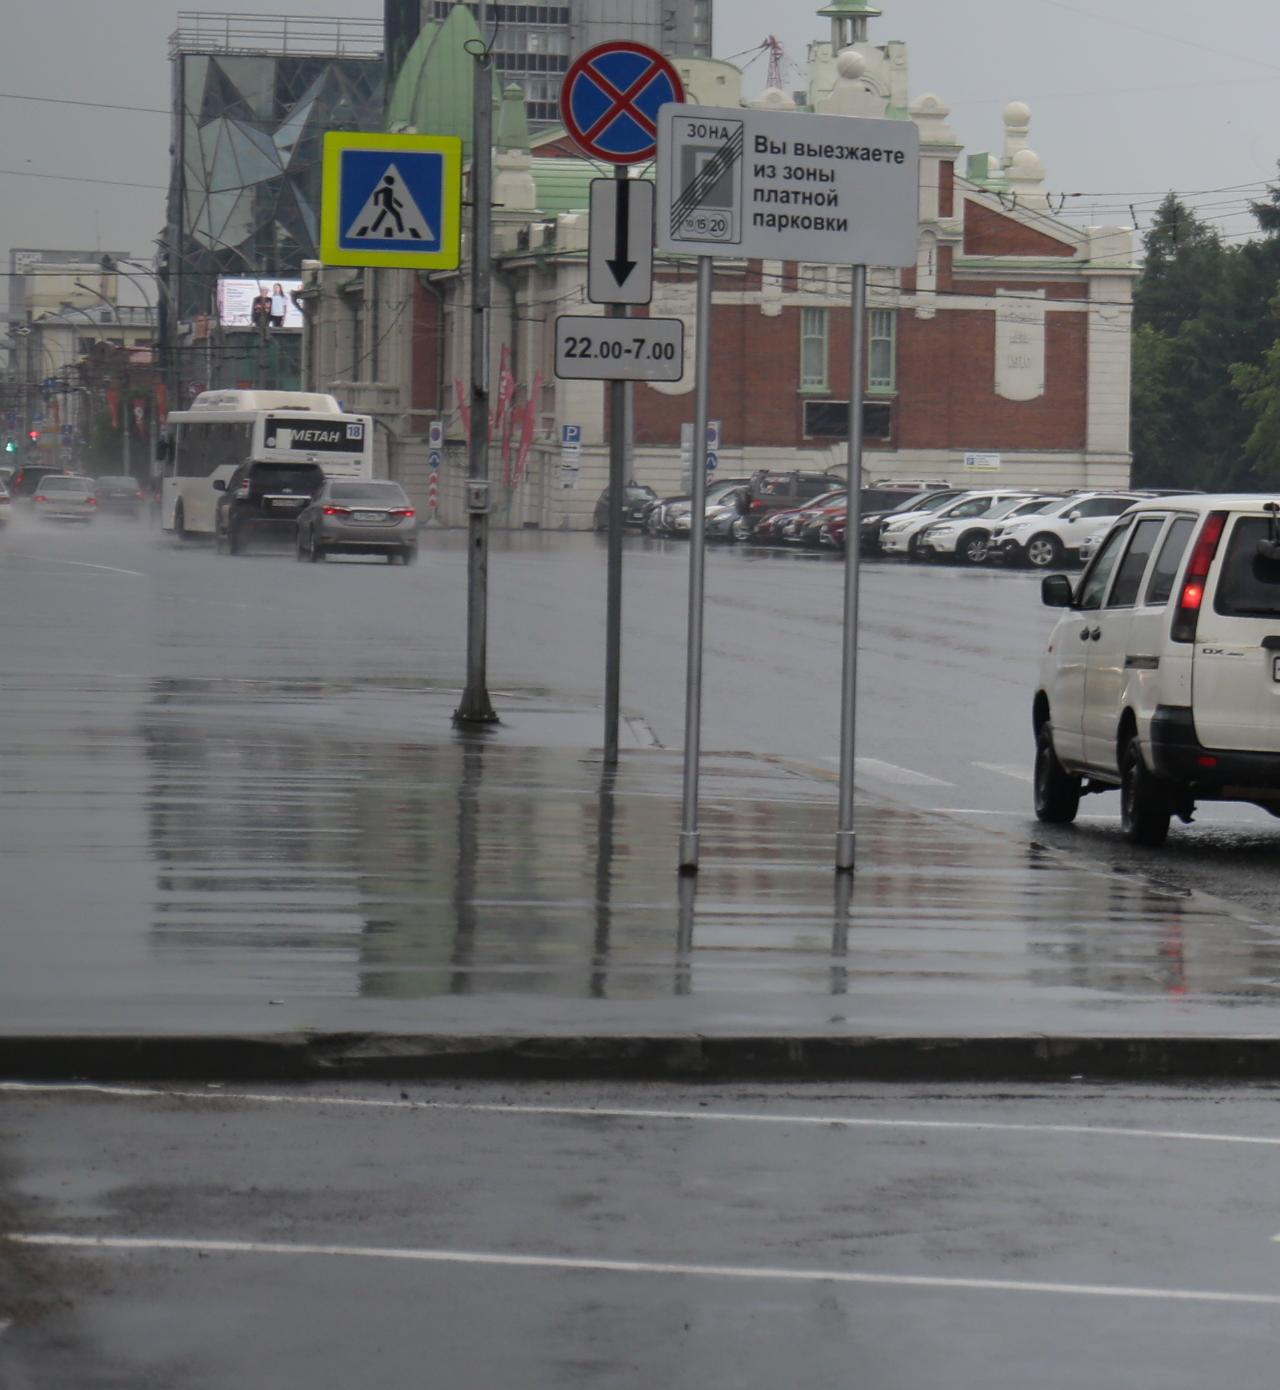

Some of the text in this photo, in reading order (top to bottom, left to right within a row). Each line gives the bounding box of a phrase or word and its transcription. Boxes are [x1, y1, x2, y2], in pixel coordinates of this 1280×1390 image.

[687, 124, 729, 140] ЗОНА
[754, 135, 905, 165] Вы выезжаете
[753, 165, 836, 183] из зоны
[753, 188, 839, 208] платной
[709, 219, 726, 232] 20
[753, 212, 849, 233] парковки
[563, 336, 675, 361] 22.00-7.00
[290, 428, 340, 443] МЕТАН
[348, 425, 361, 438] 18
